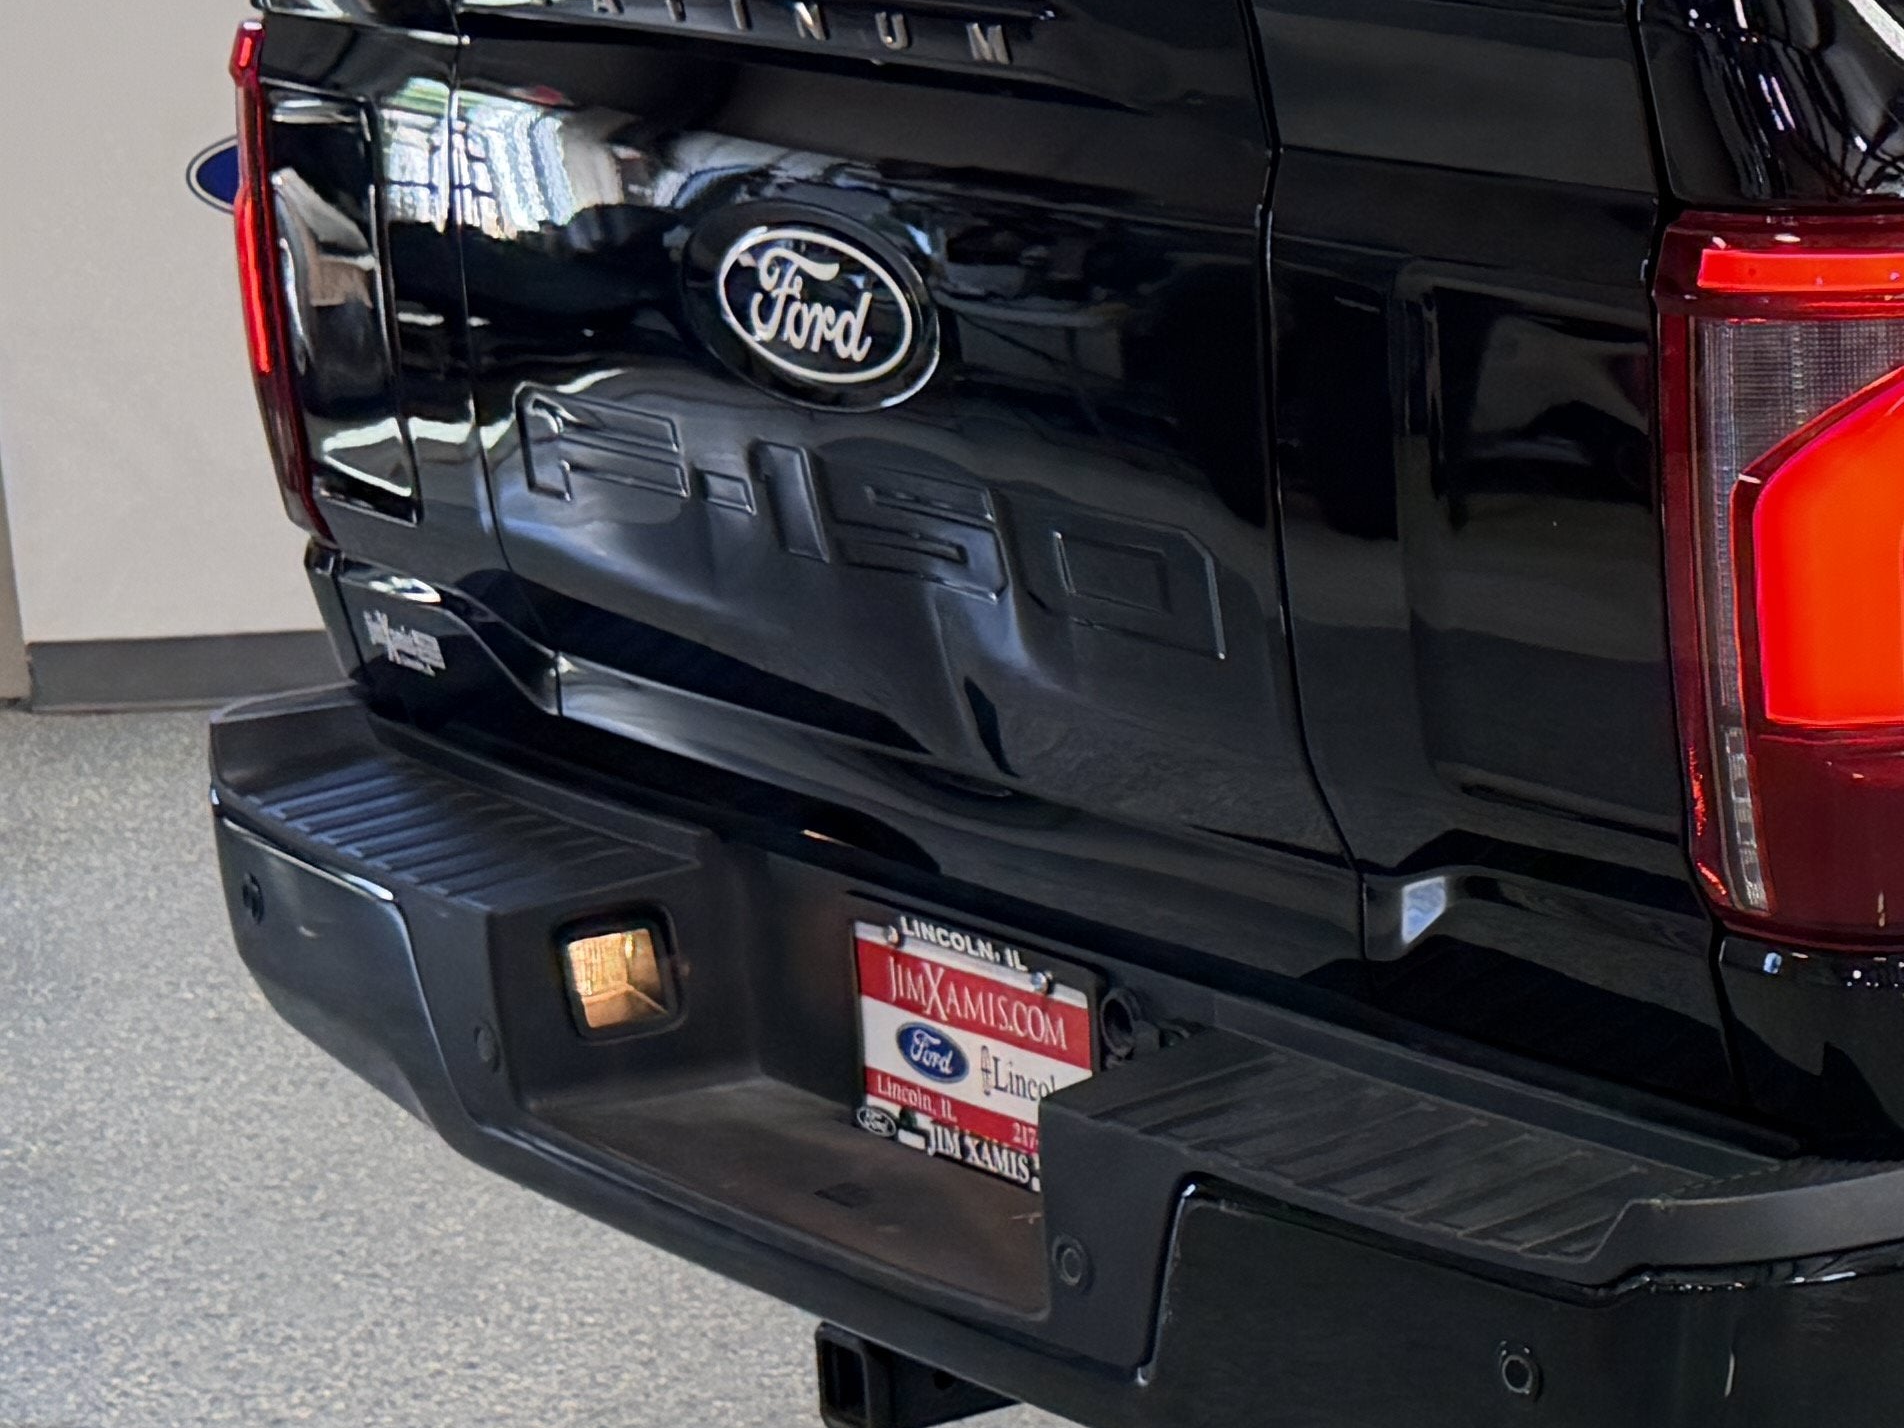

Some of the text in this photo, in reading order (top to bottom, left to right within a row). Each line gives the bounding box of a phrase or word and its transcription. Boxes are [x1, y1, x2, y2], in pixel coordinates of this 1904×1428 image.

[751, 247, 873, 362] Ford
[517, 381, 1228, 661] F-150
[900, 916, 1029, 972] LINCOLN, IL
[887, 955, 1068, 1051] JIMXAMIS.COM
[910, 1028, 954, 1075] Ford
[993, 1056, 1057, 1102] Lincol
[963, 1135, 1030, 1184] XAMIS
